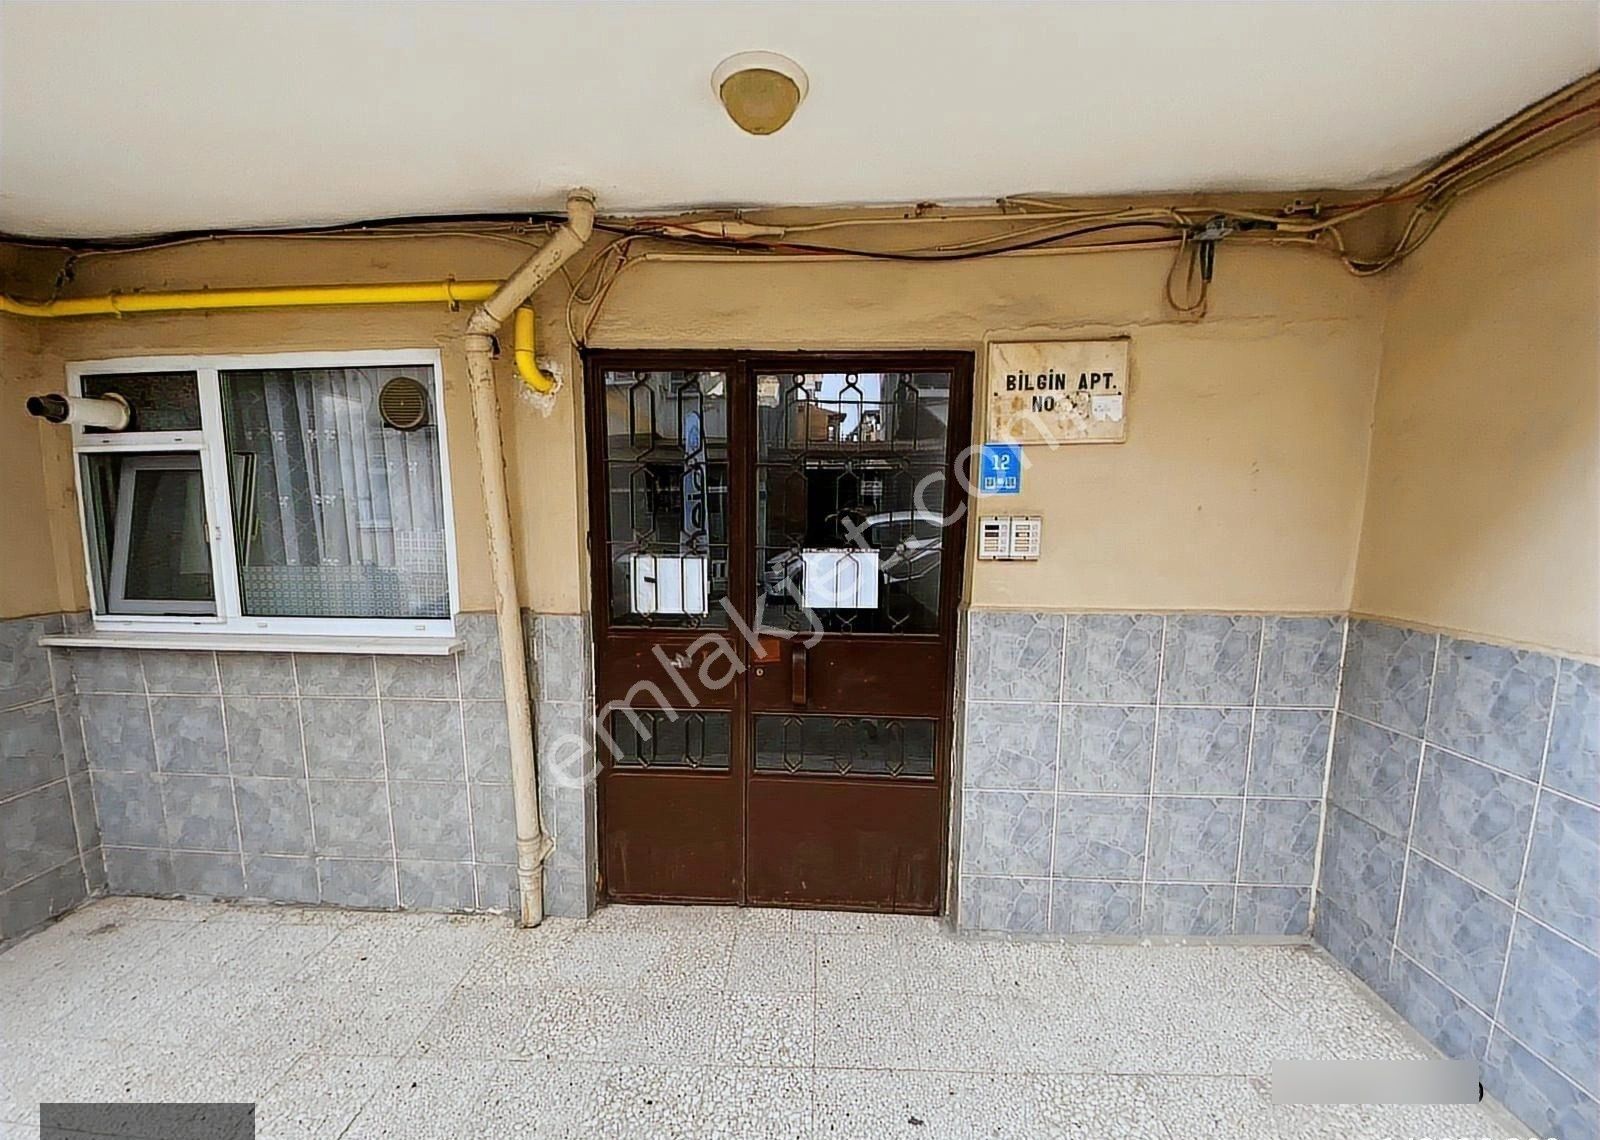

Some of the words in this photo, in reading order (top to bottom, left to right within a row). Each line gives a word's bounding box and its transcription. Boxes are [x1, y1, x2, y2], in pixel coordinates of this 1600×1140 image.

[1006, 370, 1065, 391] BİLGİN
[1078, 373, 1117, 390] APT.
[992, 454, 1011, 471] 12
